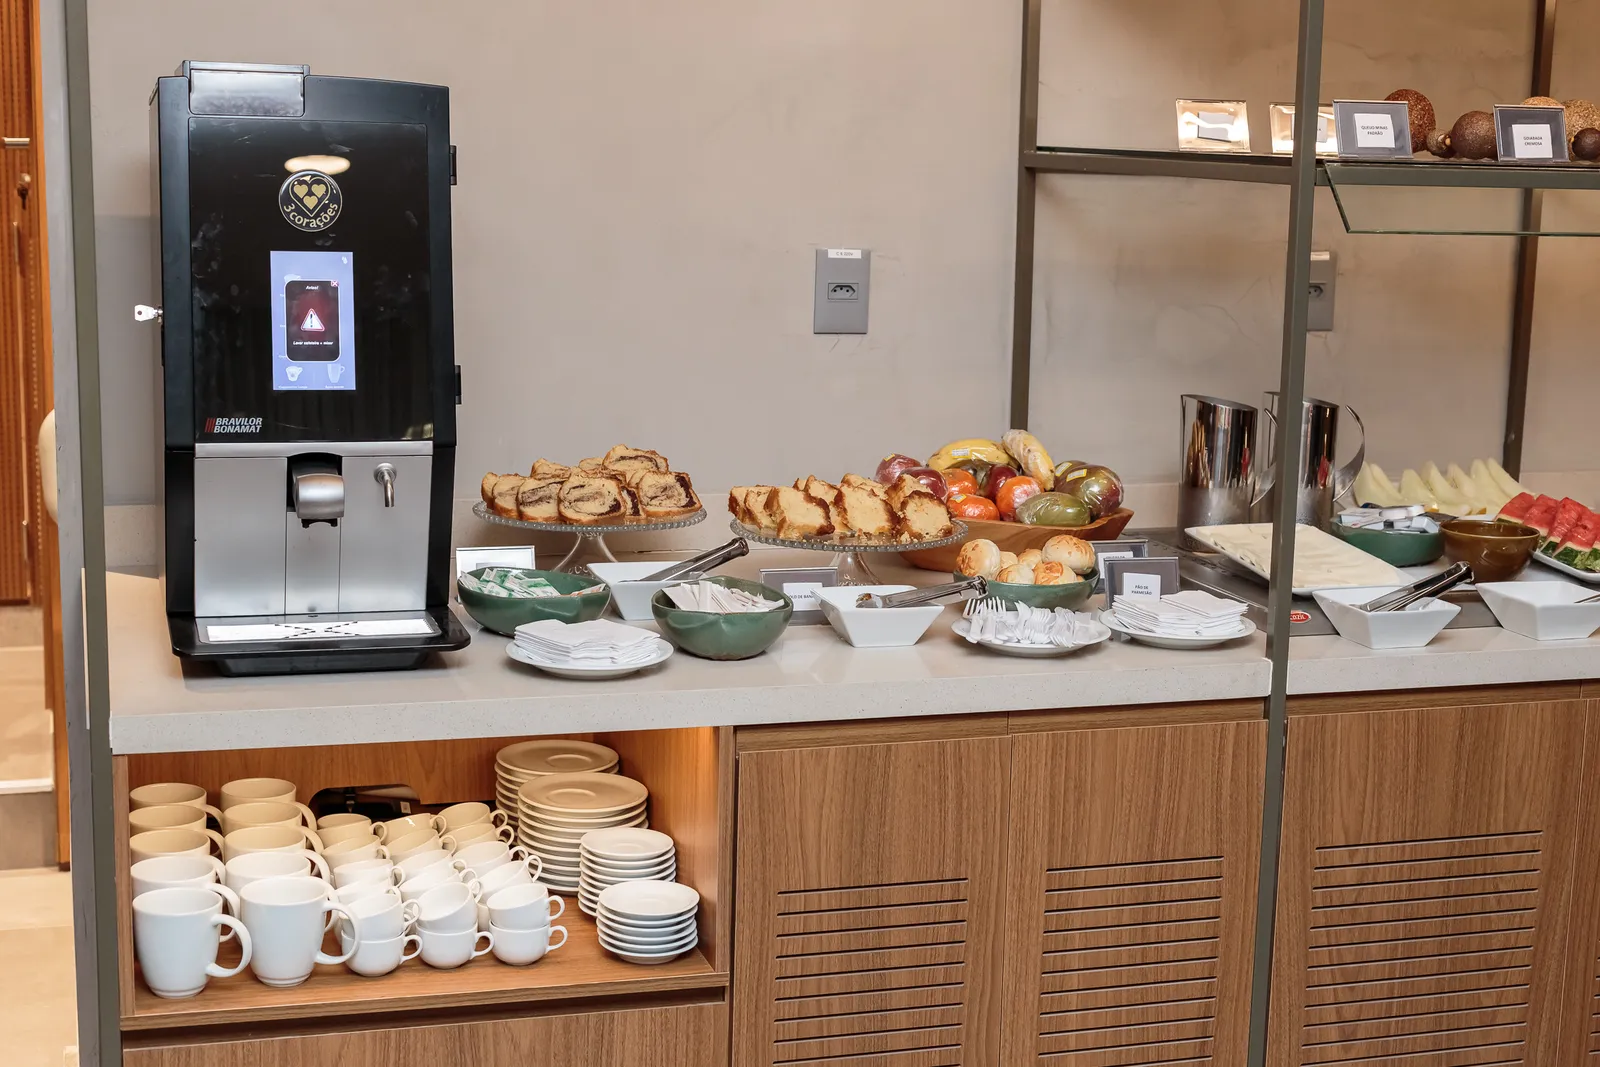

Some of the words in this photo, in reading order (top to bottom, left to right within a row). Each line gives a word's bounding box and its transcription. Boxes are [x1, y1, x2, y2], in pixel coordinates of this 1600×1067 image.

[284, 203, 296, 212] 3
[290, 203, 338, 228] corações
[215, 417, 262, 426] BRAVILOR
